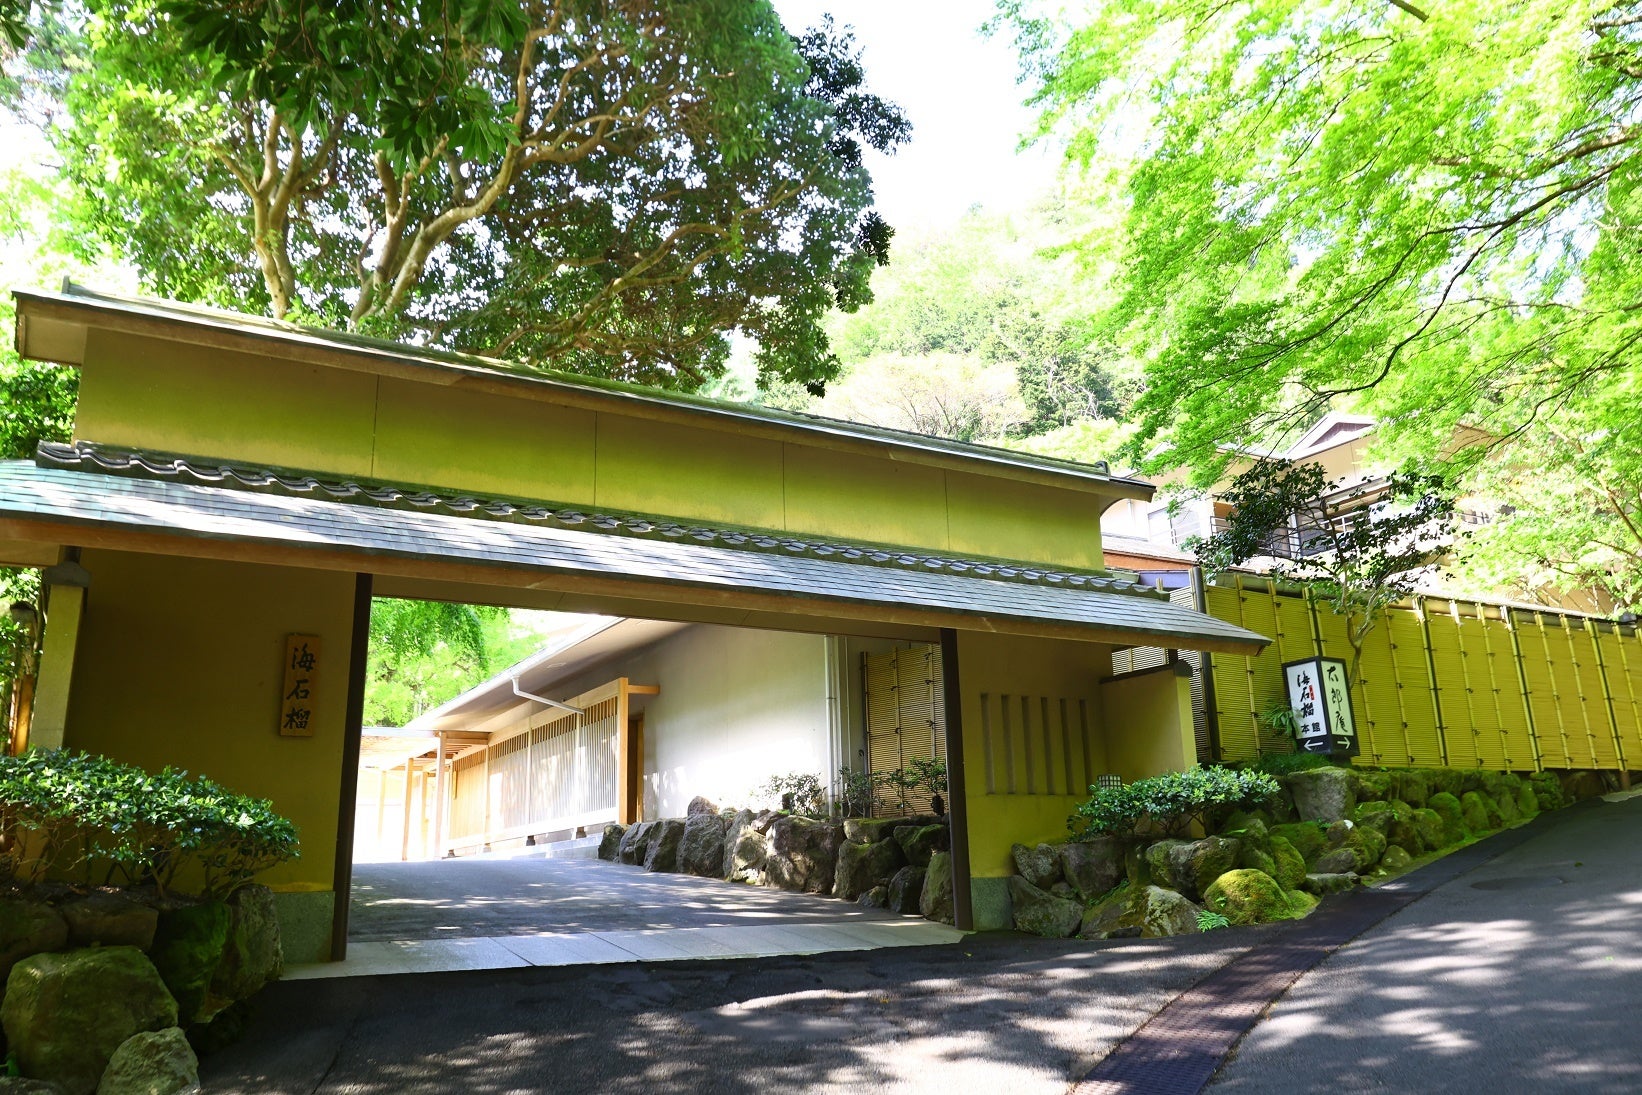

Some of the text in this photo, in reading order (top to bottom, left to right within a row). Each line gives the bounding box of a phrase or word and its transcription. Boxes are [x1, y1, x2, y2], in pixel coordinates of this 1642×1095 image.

[284, 643, 315, 729] 海石榴
[1297, 671, 1314, 718] 海石榴
[1301, 722, 1320, 734] 本館
